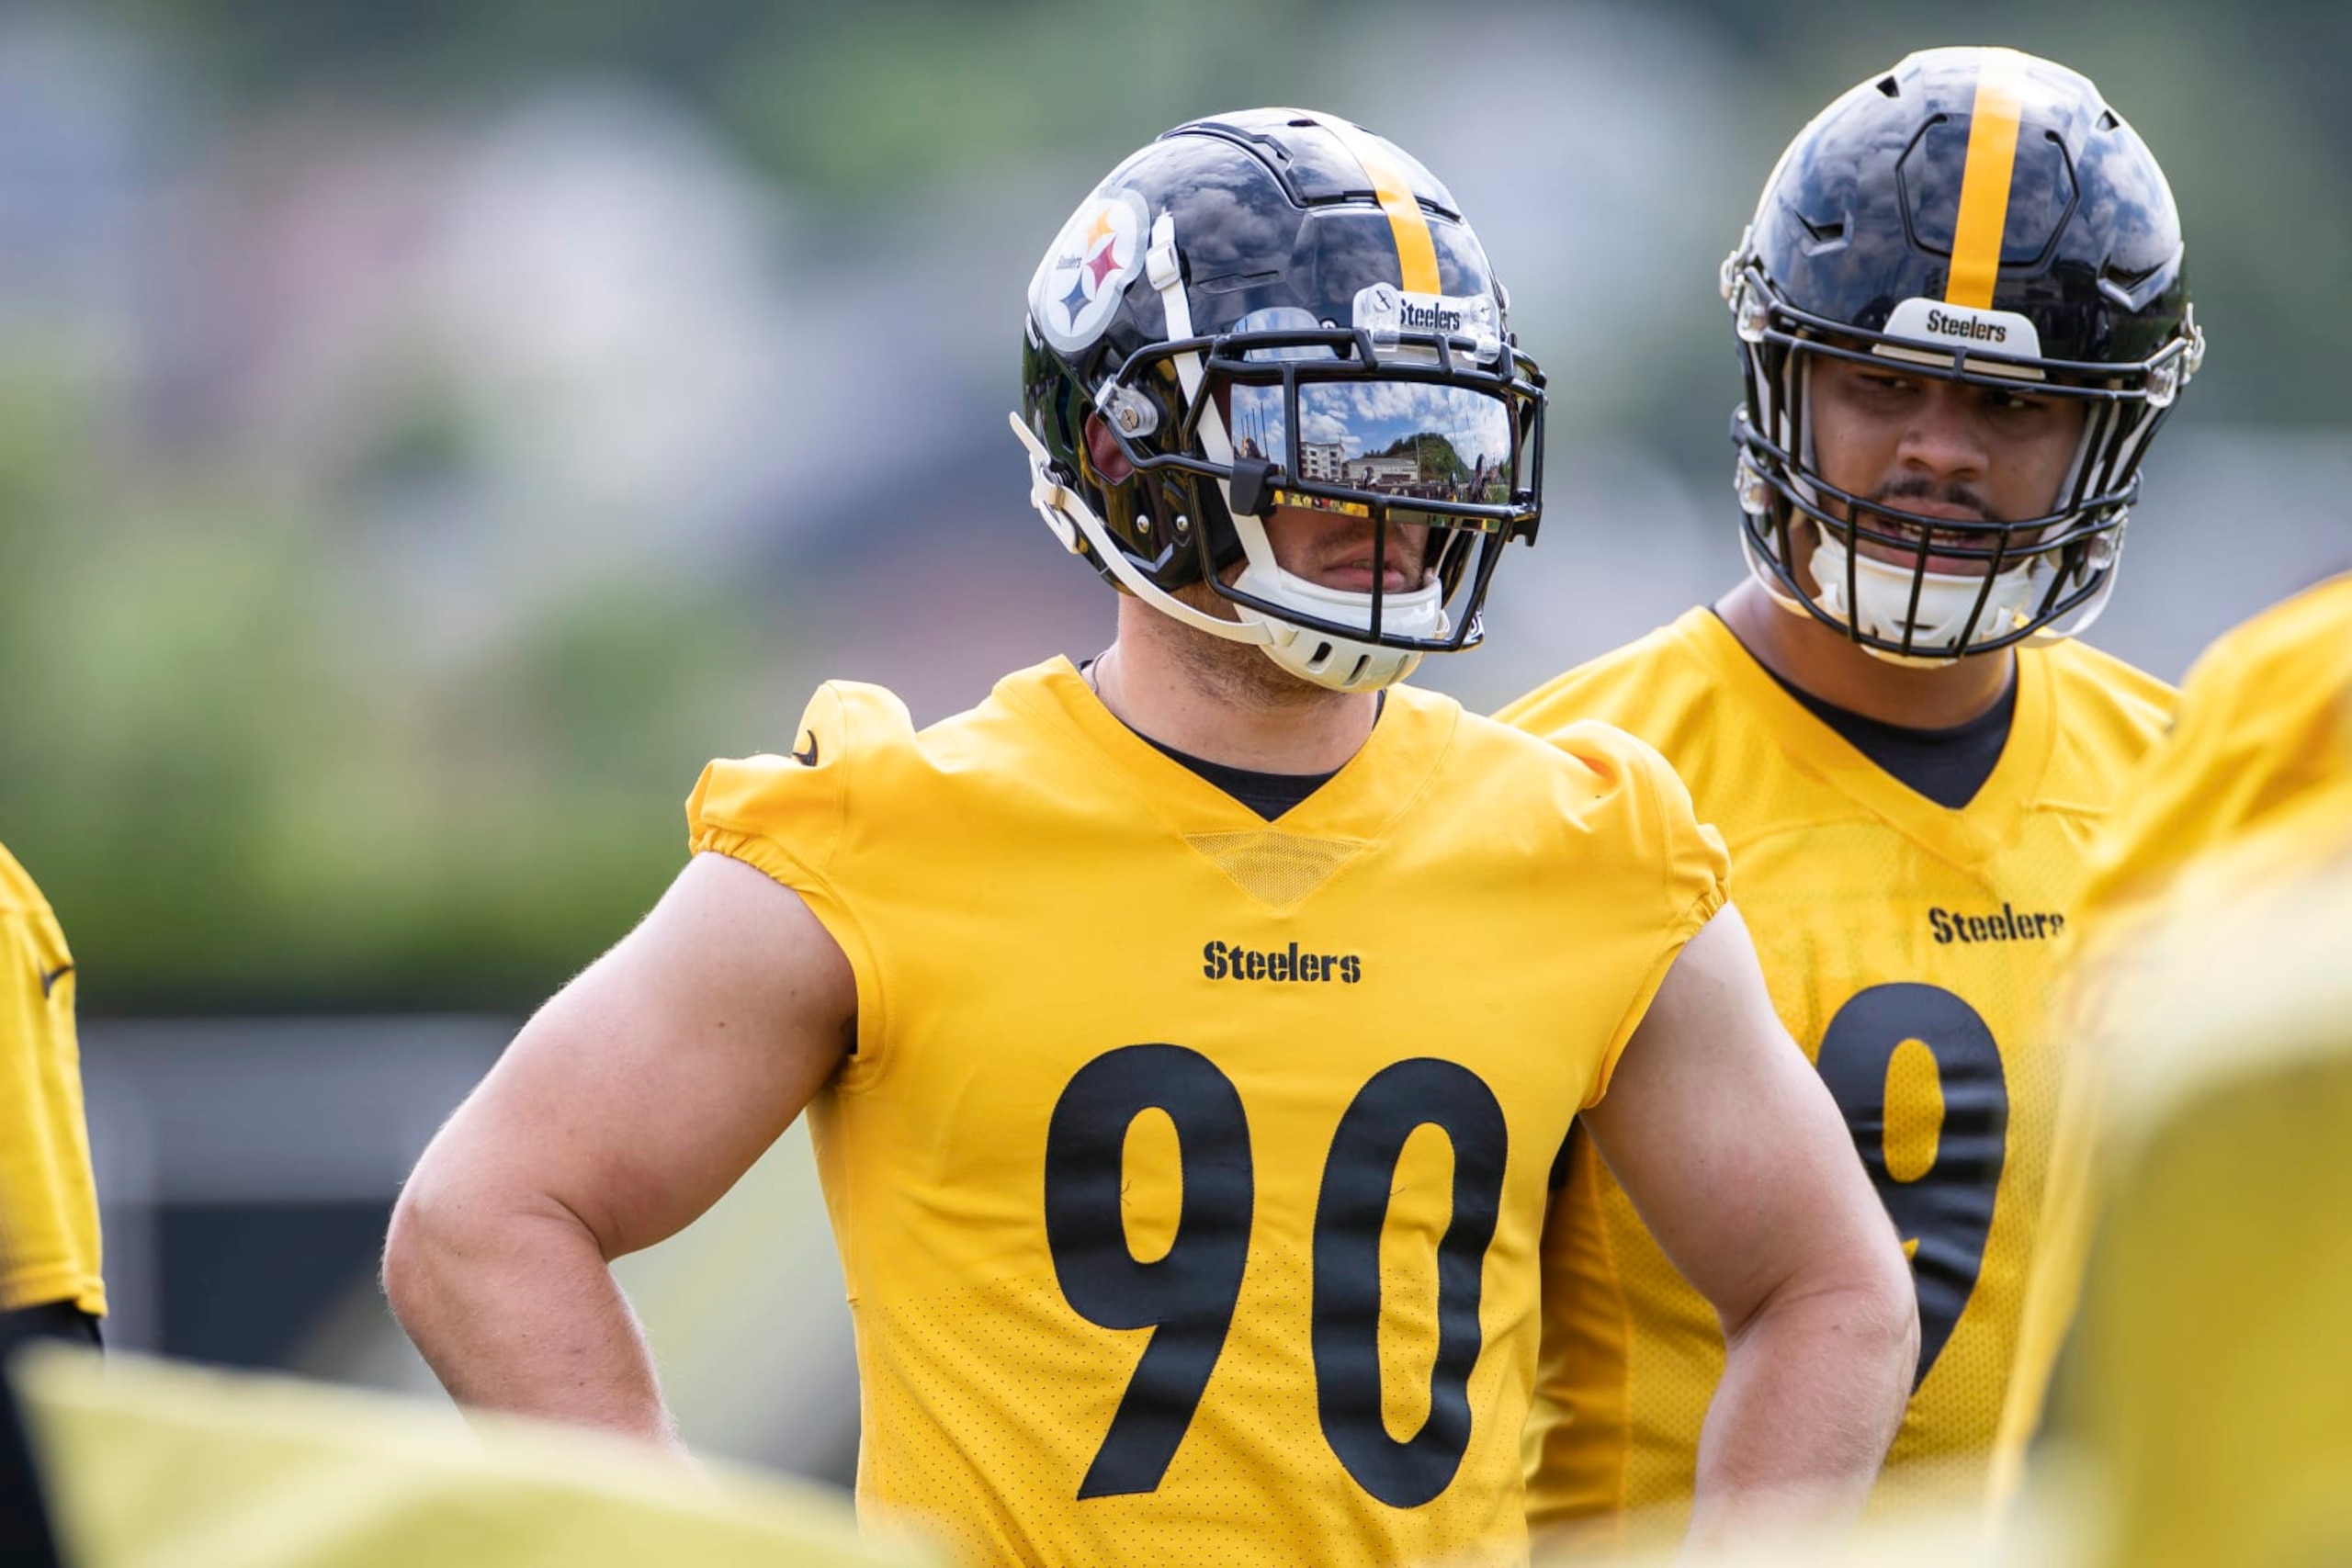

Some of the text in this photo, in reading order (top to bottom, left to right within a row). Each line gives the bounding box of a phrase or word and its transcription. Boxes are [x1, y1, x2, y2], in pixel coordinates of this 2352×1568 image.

[1927, 310, 2007, 343] Steelers
[1203, 941, 1361, 983] Steelers
[1045, 1043, 1508, 1508] 90
